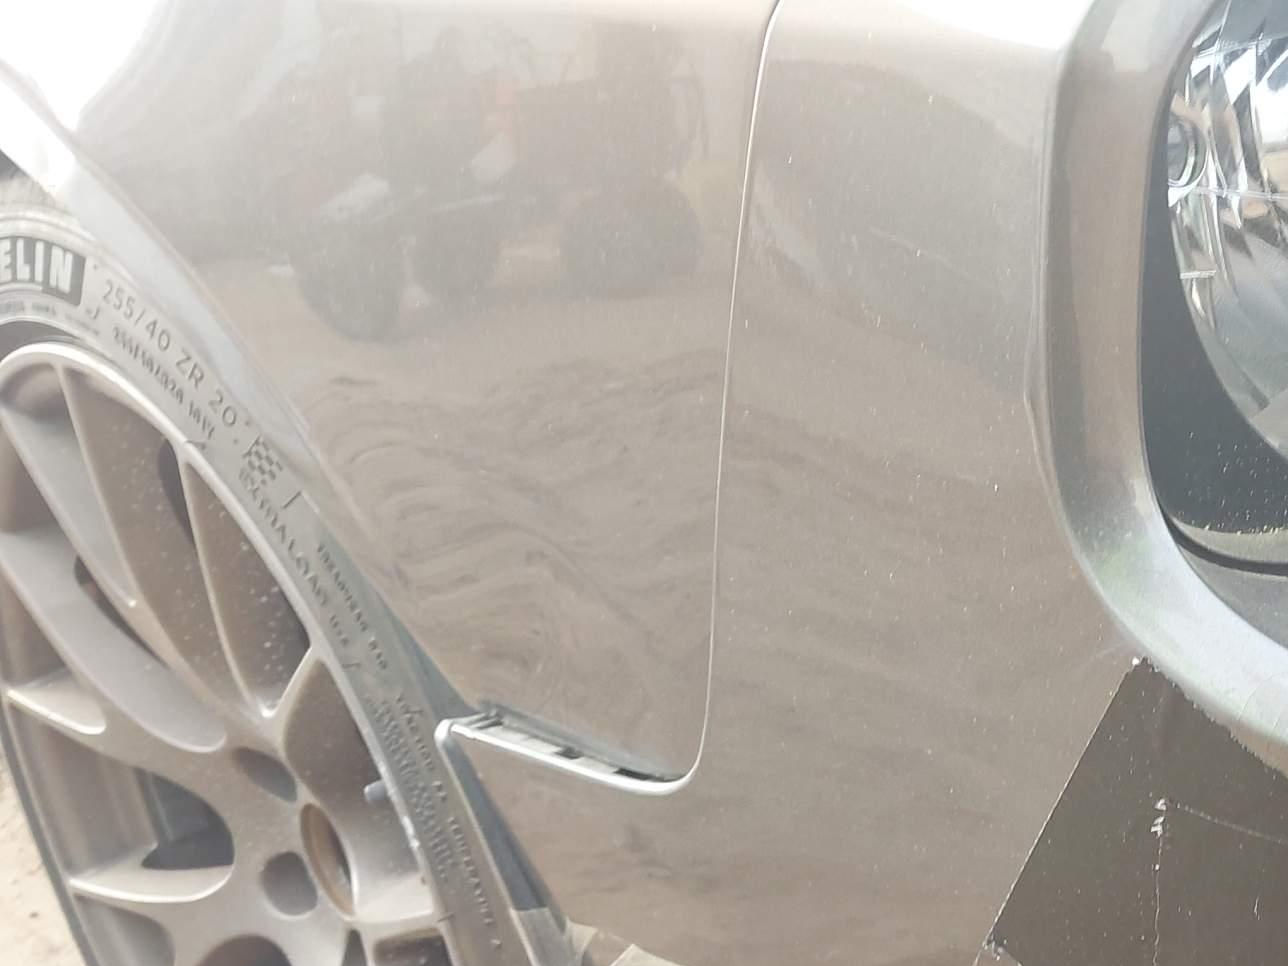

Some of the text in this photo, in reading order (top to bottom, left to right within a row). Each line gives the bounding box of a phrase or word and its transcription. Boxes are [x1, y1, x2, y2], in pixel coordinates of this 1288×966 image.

[102, 278, 238, 428] 255/40 ZR 20
